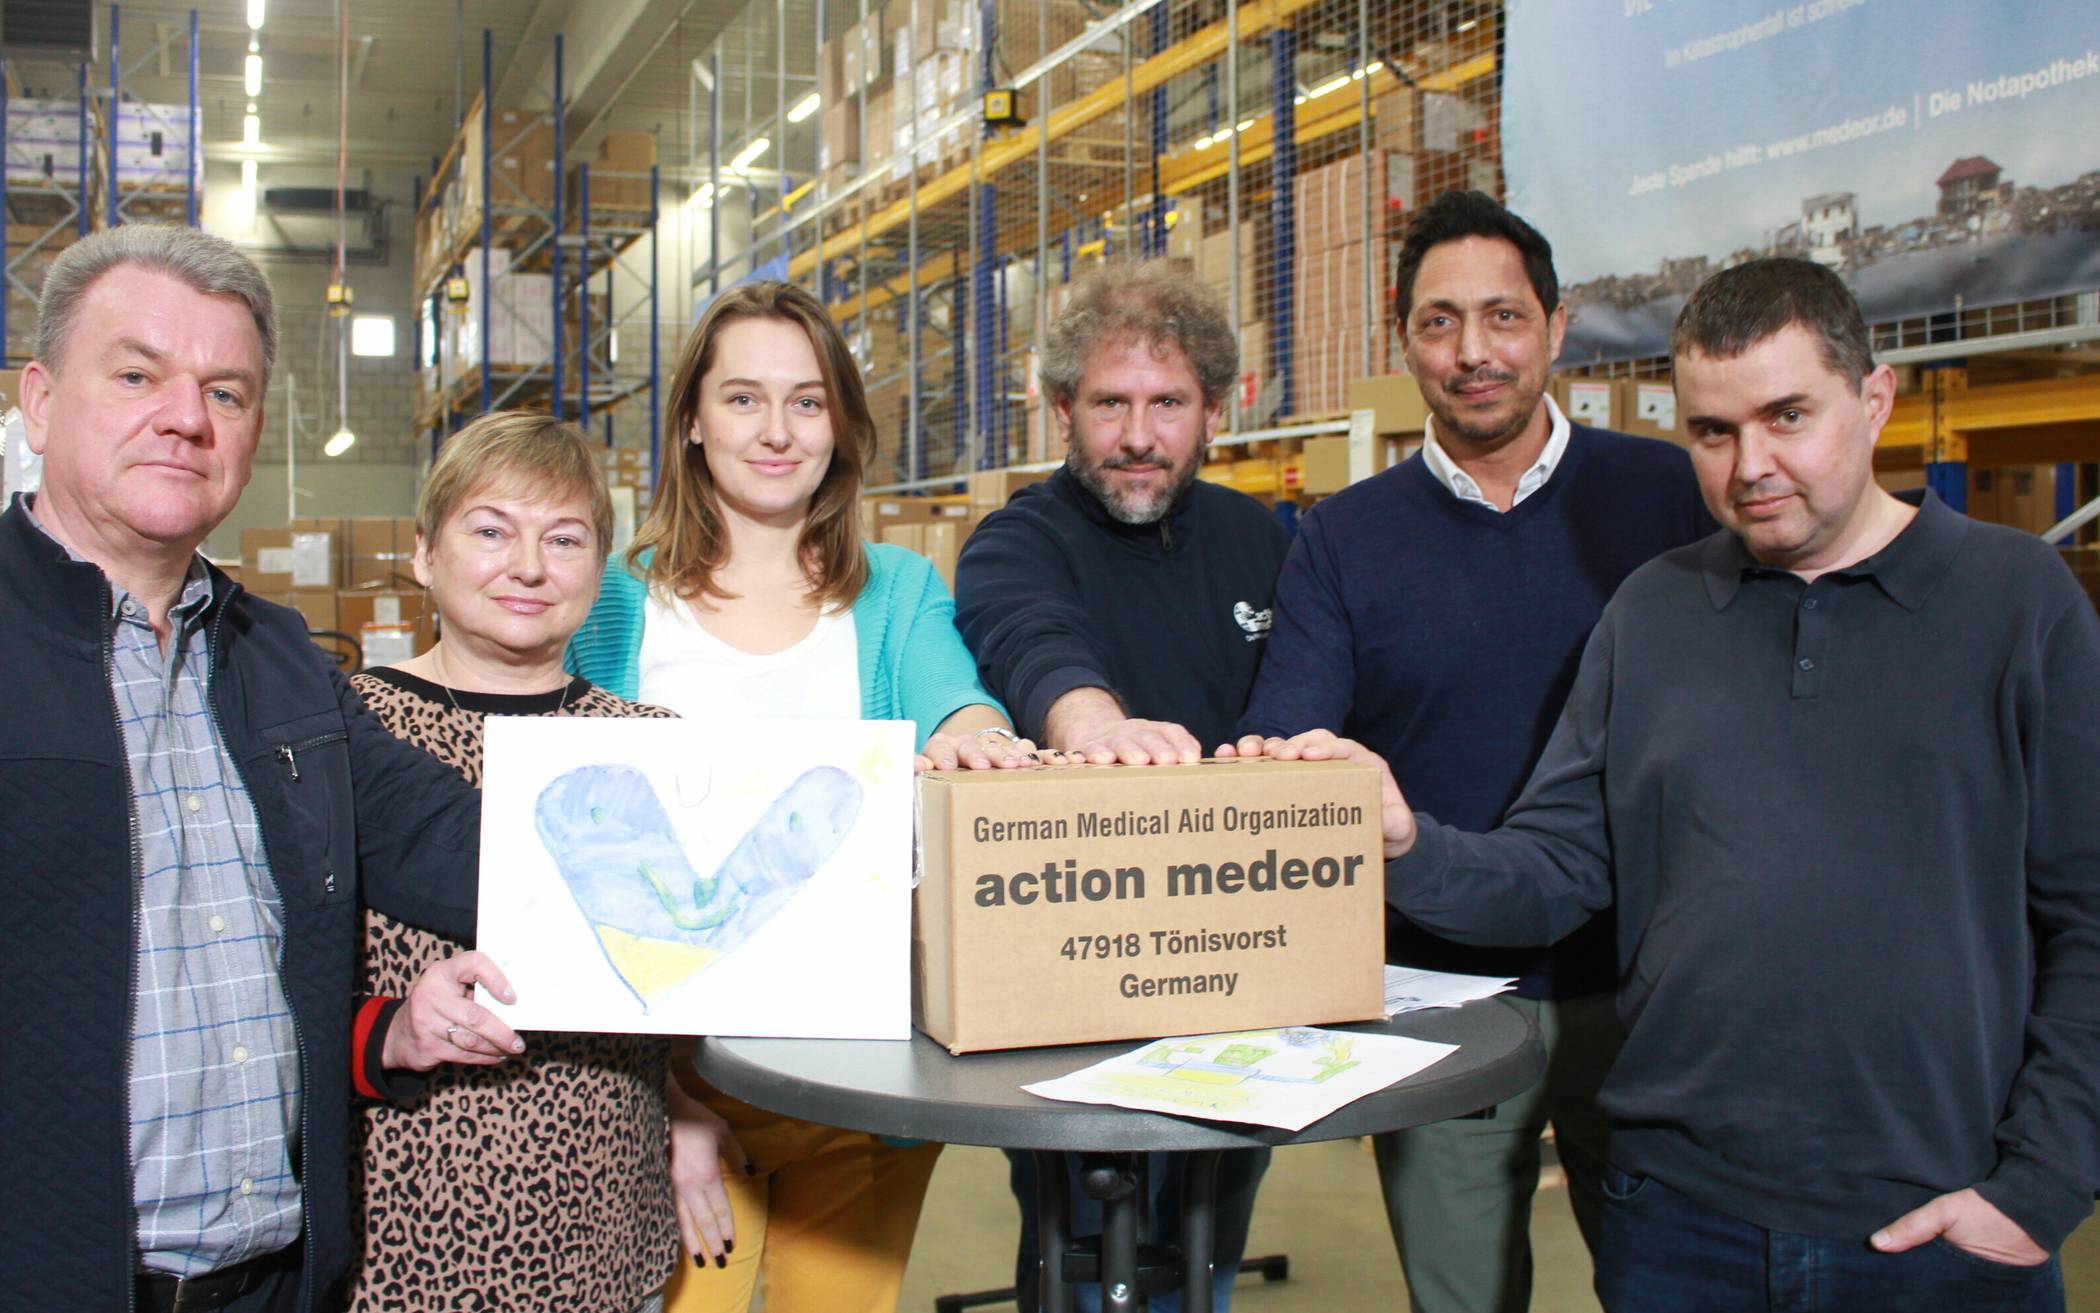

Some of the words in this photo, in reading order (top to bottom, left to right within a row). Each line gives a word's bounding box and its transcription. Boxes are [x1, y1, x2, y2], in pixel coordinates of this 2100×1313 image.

[1669, 154, 1723, 188] Spende
[1765, 105, 1908, 160] www.medeor.de
[1929, 89, 1962, 118] Die
[1967, 50, 2100, 107] Notapothek
[974, 814, 1068, 843] German
[1077, 808, 1170, 838] Medical
[1178, 806, 1214, 834] Aid
[1223, 801, 1363, 836] Organization
[974, 858, 1145, 908] action
[1167, 849, 1365, 898] medeor
[1061, 933, 1142, 961] 47918
[1150, 924, 1288, 956] Tönisvorst
[1120, 971, 1239, 999] Germany
